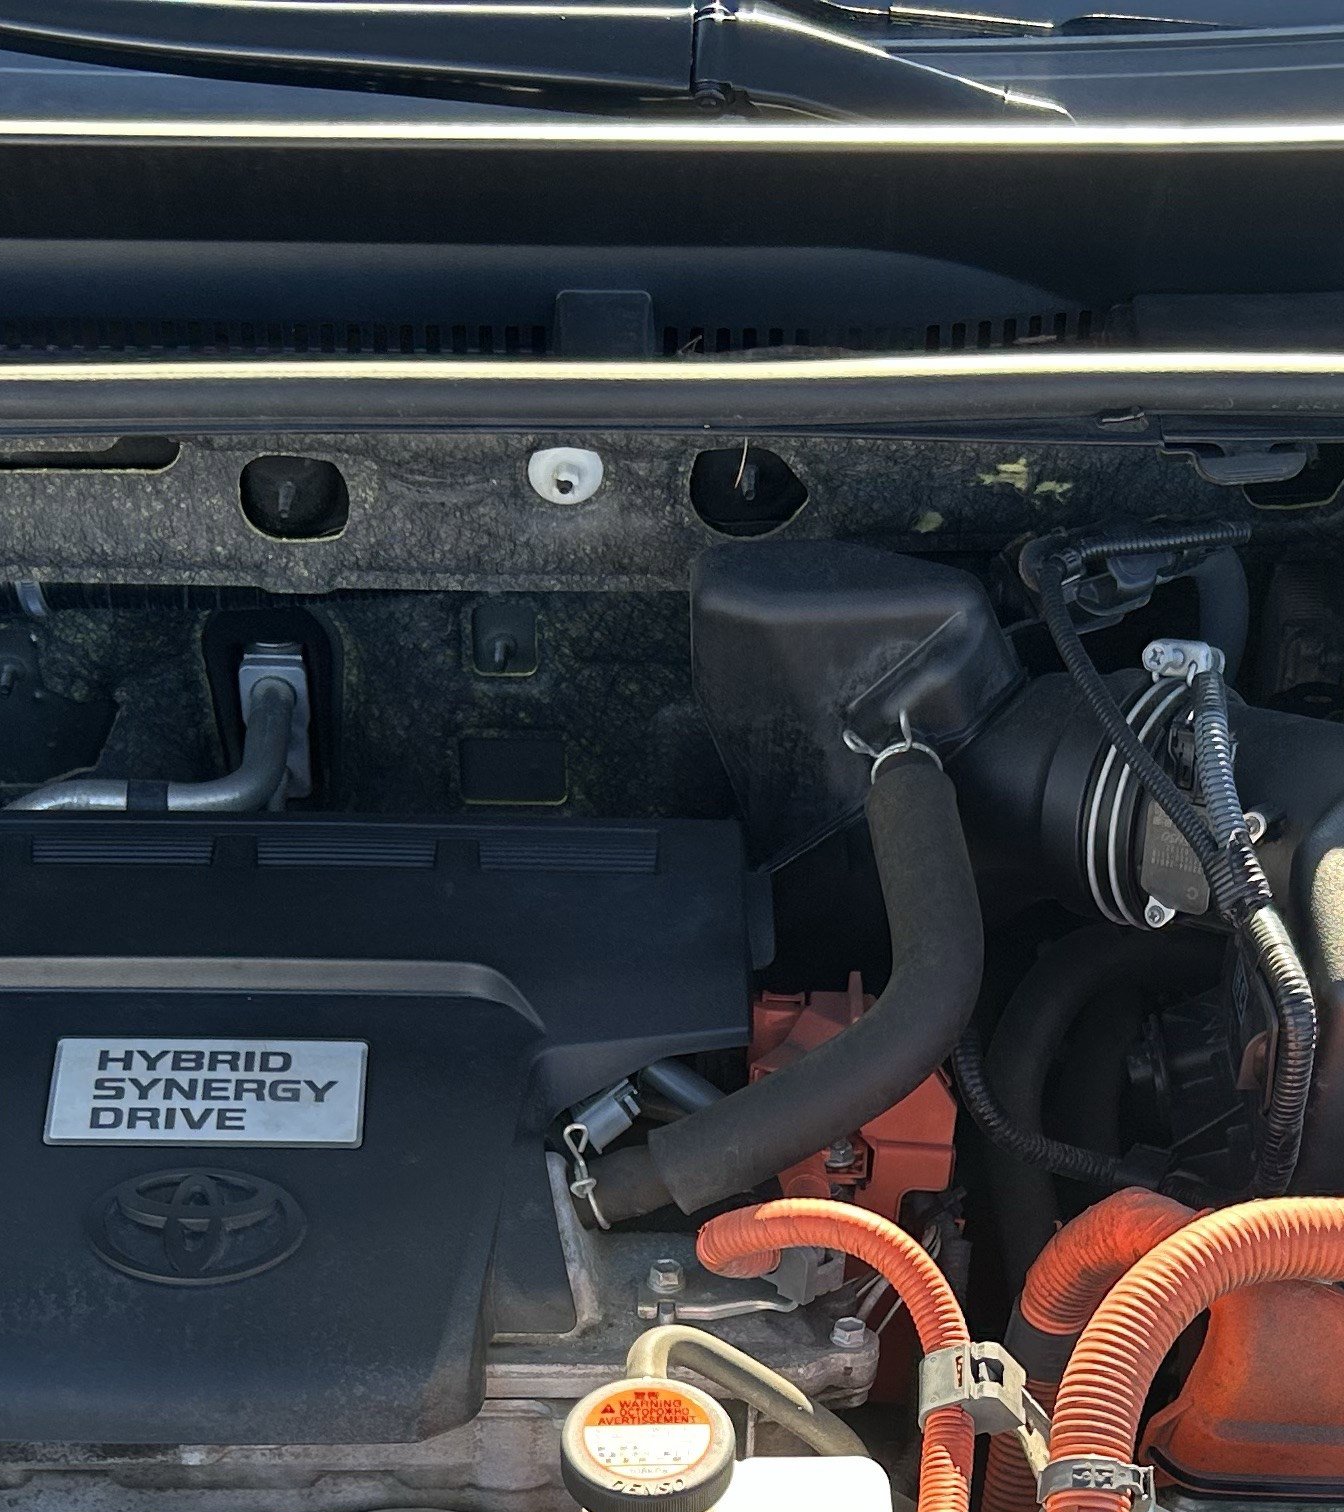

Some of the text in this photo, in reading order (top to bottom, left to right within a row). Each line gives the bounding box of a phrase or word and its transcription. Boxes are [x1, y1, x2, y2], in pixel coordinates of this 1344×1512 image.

[97, 1050, 293, 1073] HYBRID
[93, 1077, 338, 1102] SYNERGY
[89, 1107, 247, 1130] DRIVE
[619, 1399, 682, 1408] WARNING
[598, 1416, 696, 1425] AVERTISSEMENT
